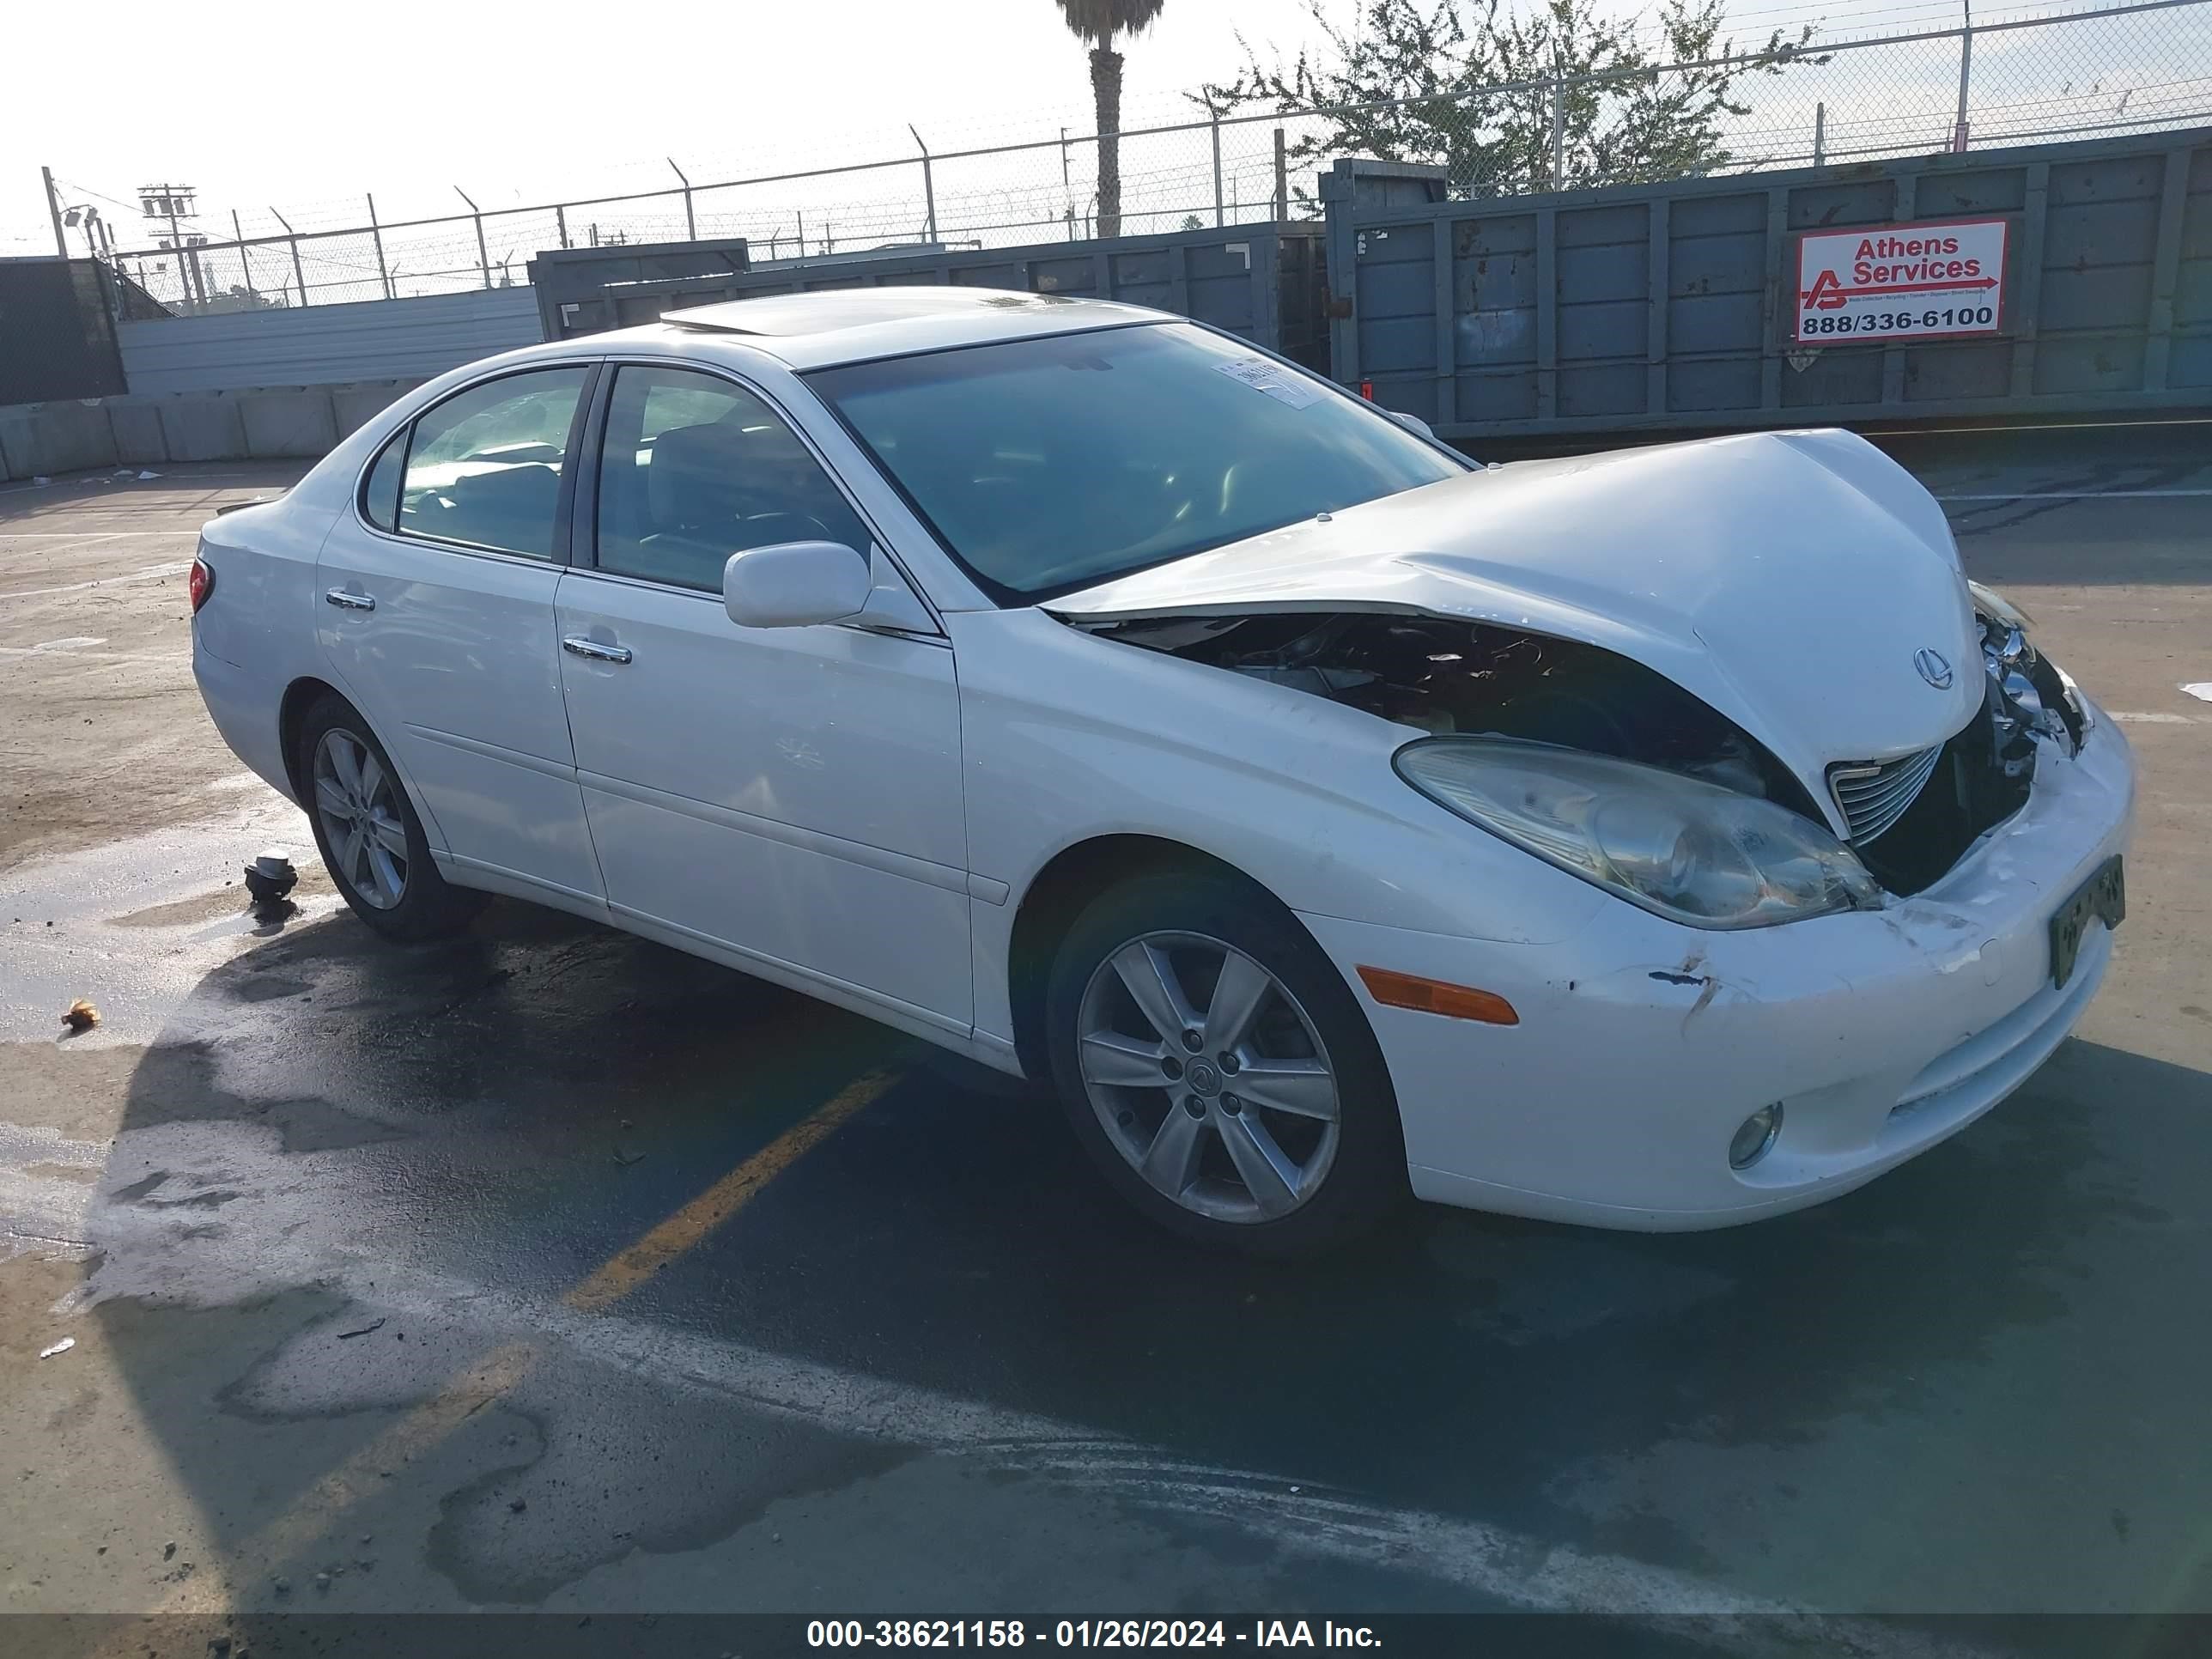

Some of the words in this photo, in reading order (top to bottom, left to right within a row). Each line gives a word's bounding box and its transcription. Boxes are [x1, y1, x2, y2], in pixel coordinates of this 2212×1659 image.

[1856, 238, 1958, 260] Athens
[1853, 258, 1980, 284] Services
[1803, 307, 1992, 334] 888/336-6100
